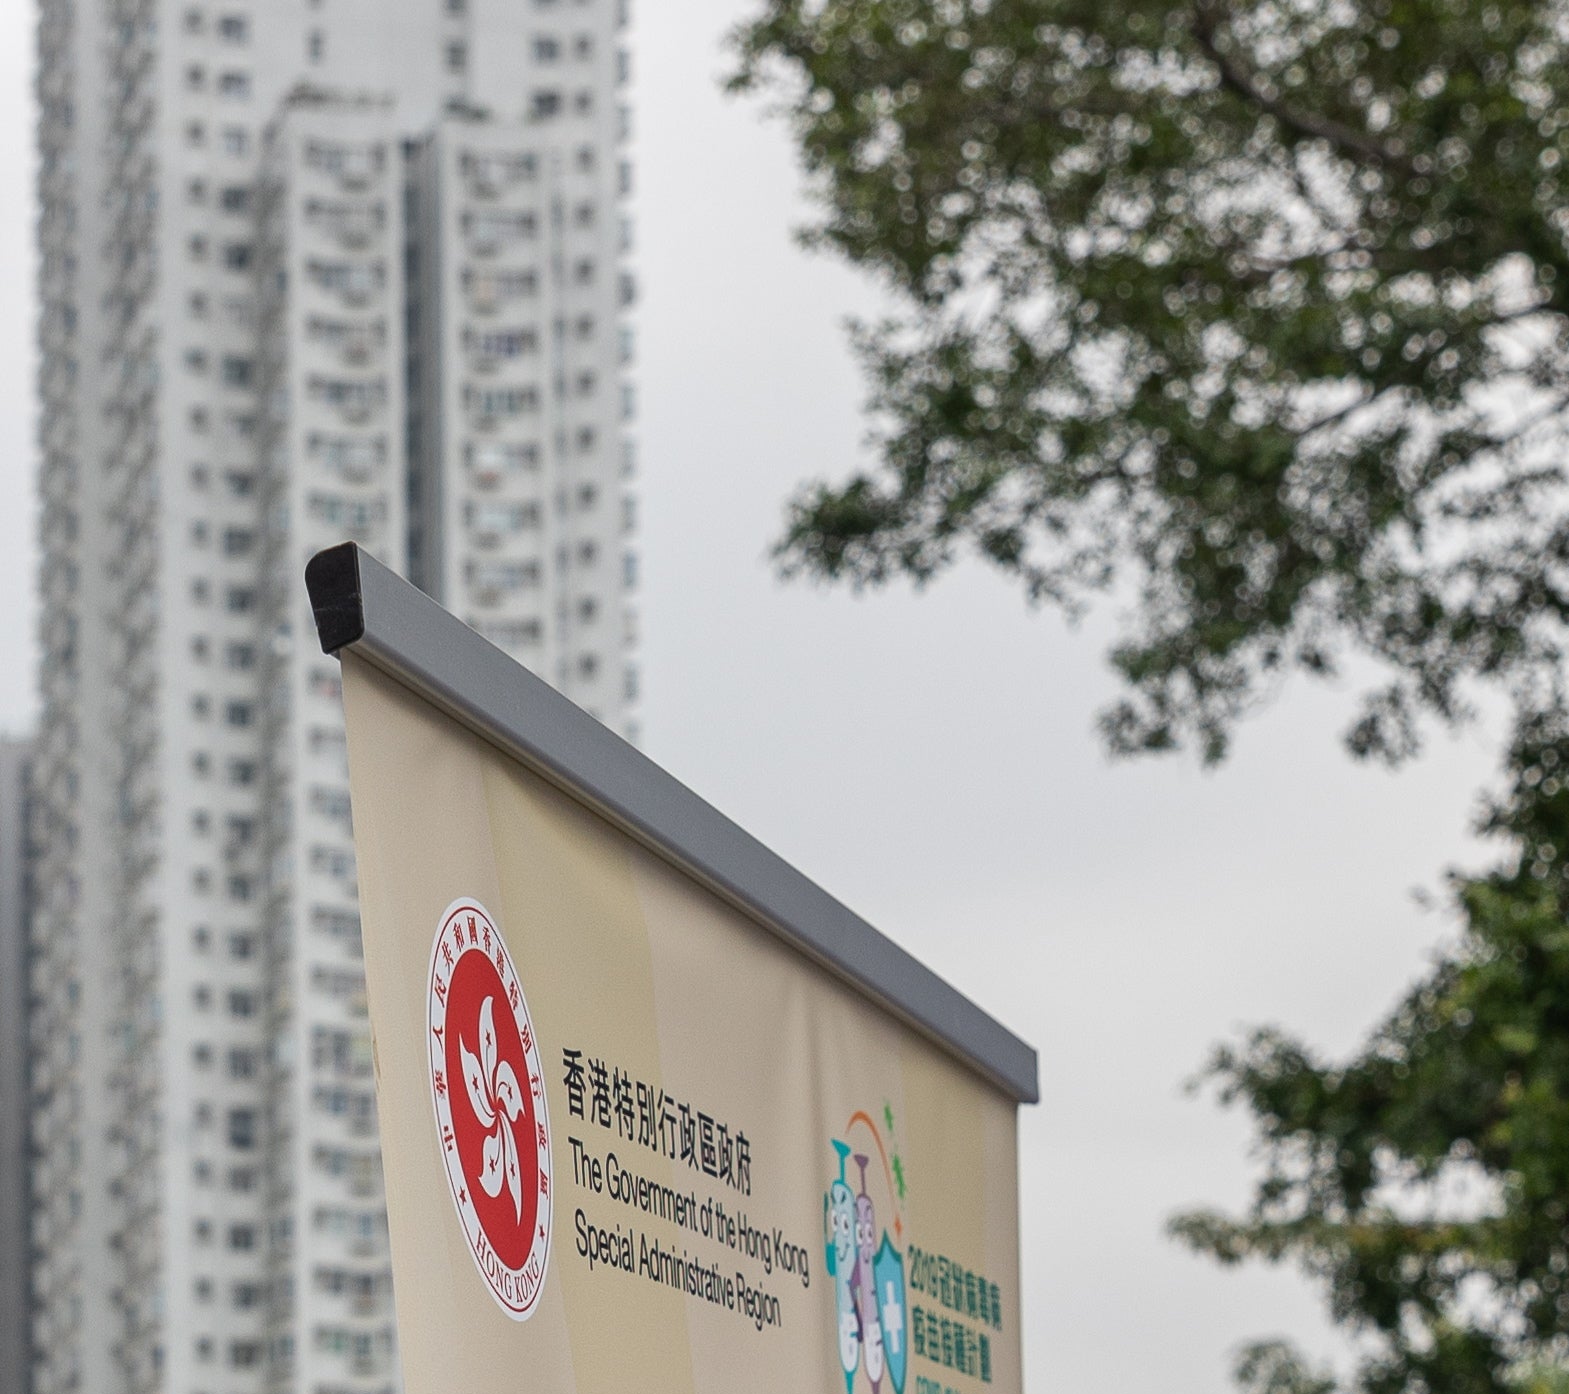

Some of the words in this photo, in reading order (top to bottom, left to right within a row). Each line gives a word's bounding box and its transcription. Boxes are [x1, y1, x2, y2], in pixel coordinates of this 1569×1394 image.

[562, 1047, 752, 1197] 香港特別行政區政府
[476, 1227, 512, 1300] HONG
[514, 1251, 540, 1303] KONG
[567, 1136, 603, 1193] The
[605, 1152, 698, 1232] Government
[699, 1196, 713, 1240] of
[715, 1202, 737, 1249] the
[737, 1210, 772, 1275] Hong
[773, 1226, 811, 1288] Kong
[574, 1207, 635, 1271] Special
[638, 1232, 735, 1311] Administrative
[735, 1271, 782, 1332] Region
